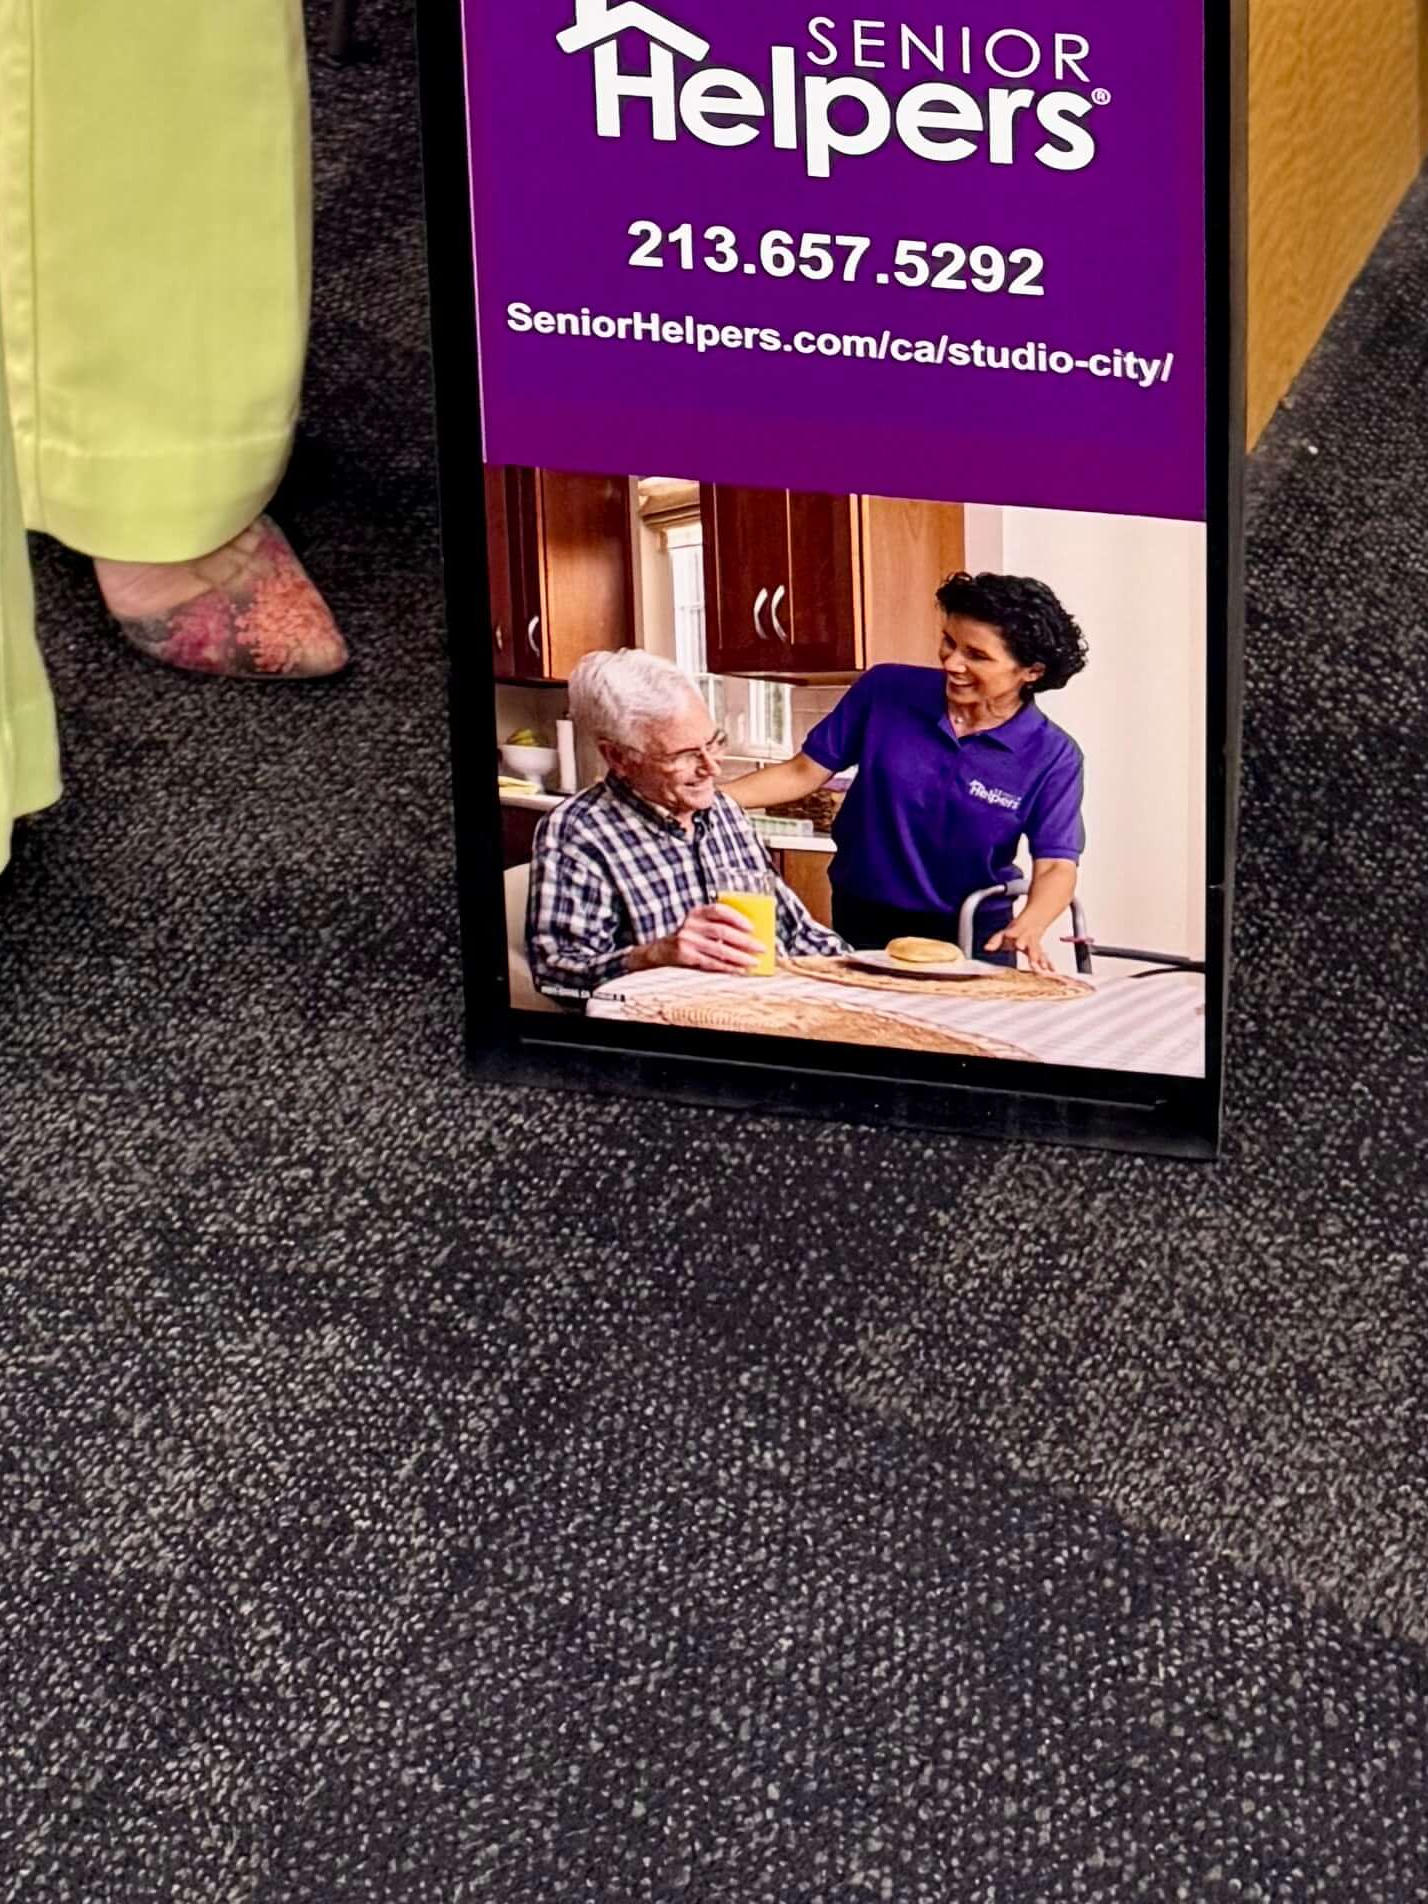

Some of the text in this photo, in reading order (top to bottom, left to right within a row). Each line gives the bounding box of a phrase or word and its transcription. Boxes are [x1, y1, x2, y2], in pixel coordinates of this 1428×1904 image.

[807, 17, 1090, 83] SENIOR
[593, 39, 1096, 178] Helpers
[628, 221, 1044, 297] 213.657.5292
[507, 302, 1174, 383] SeniorHelpers.com/ca/studio-city/
